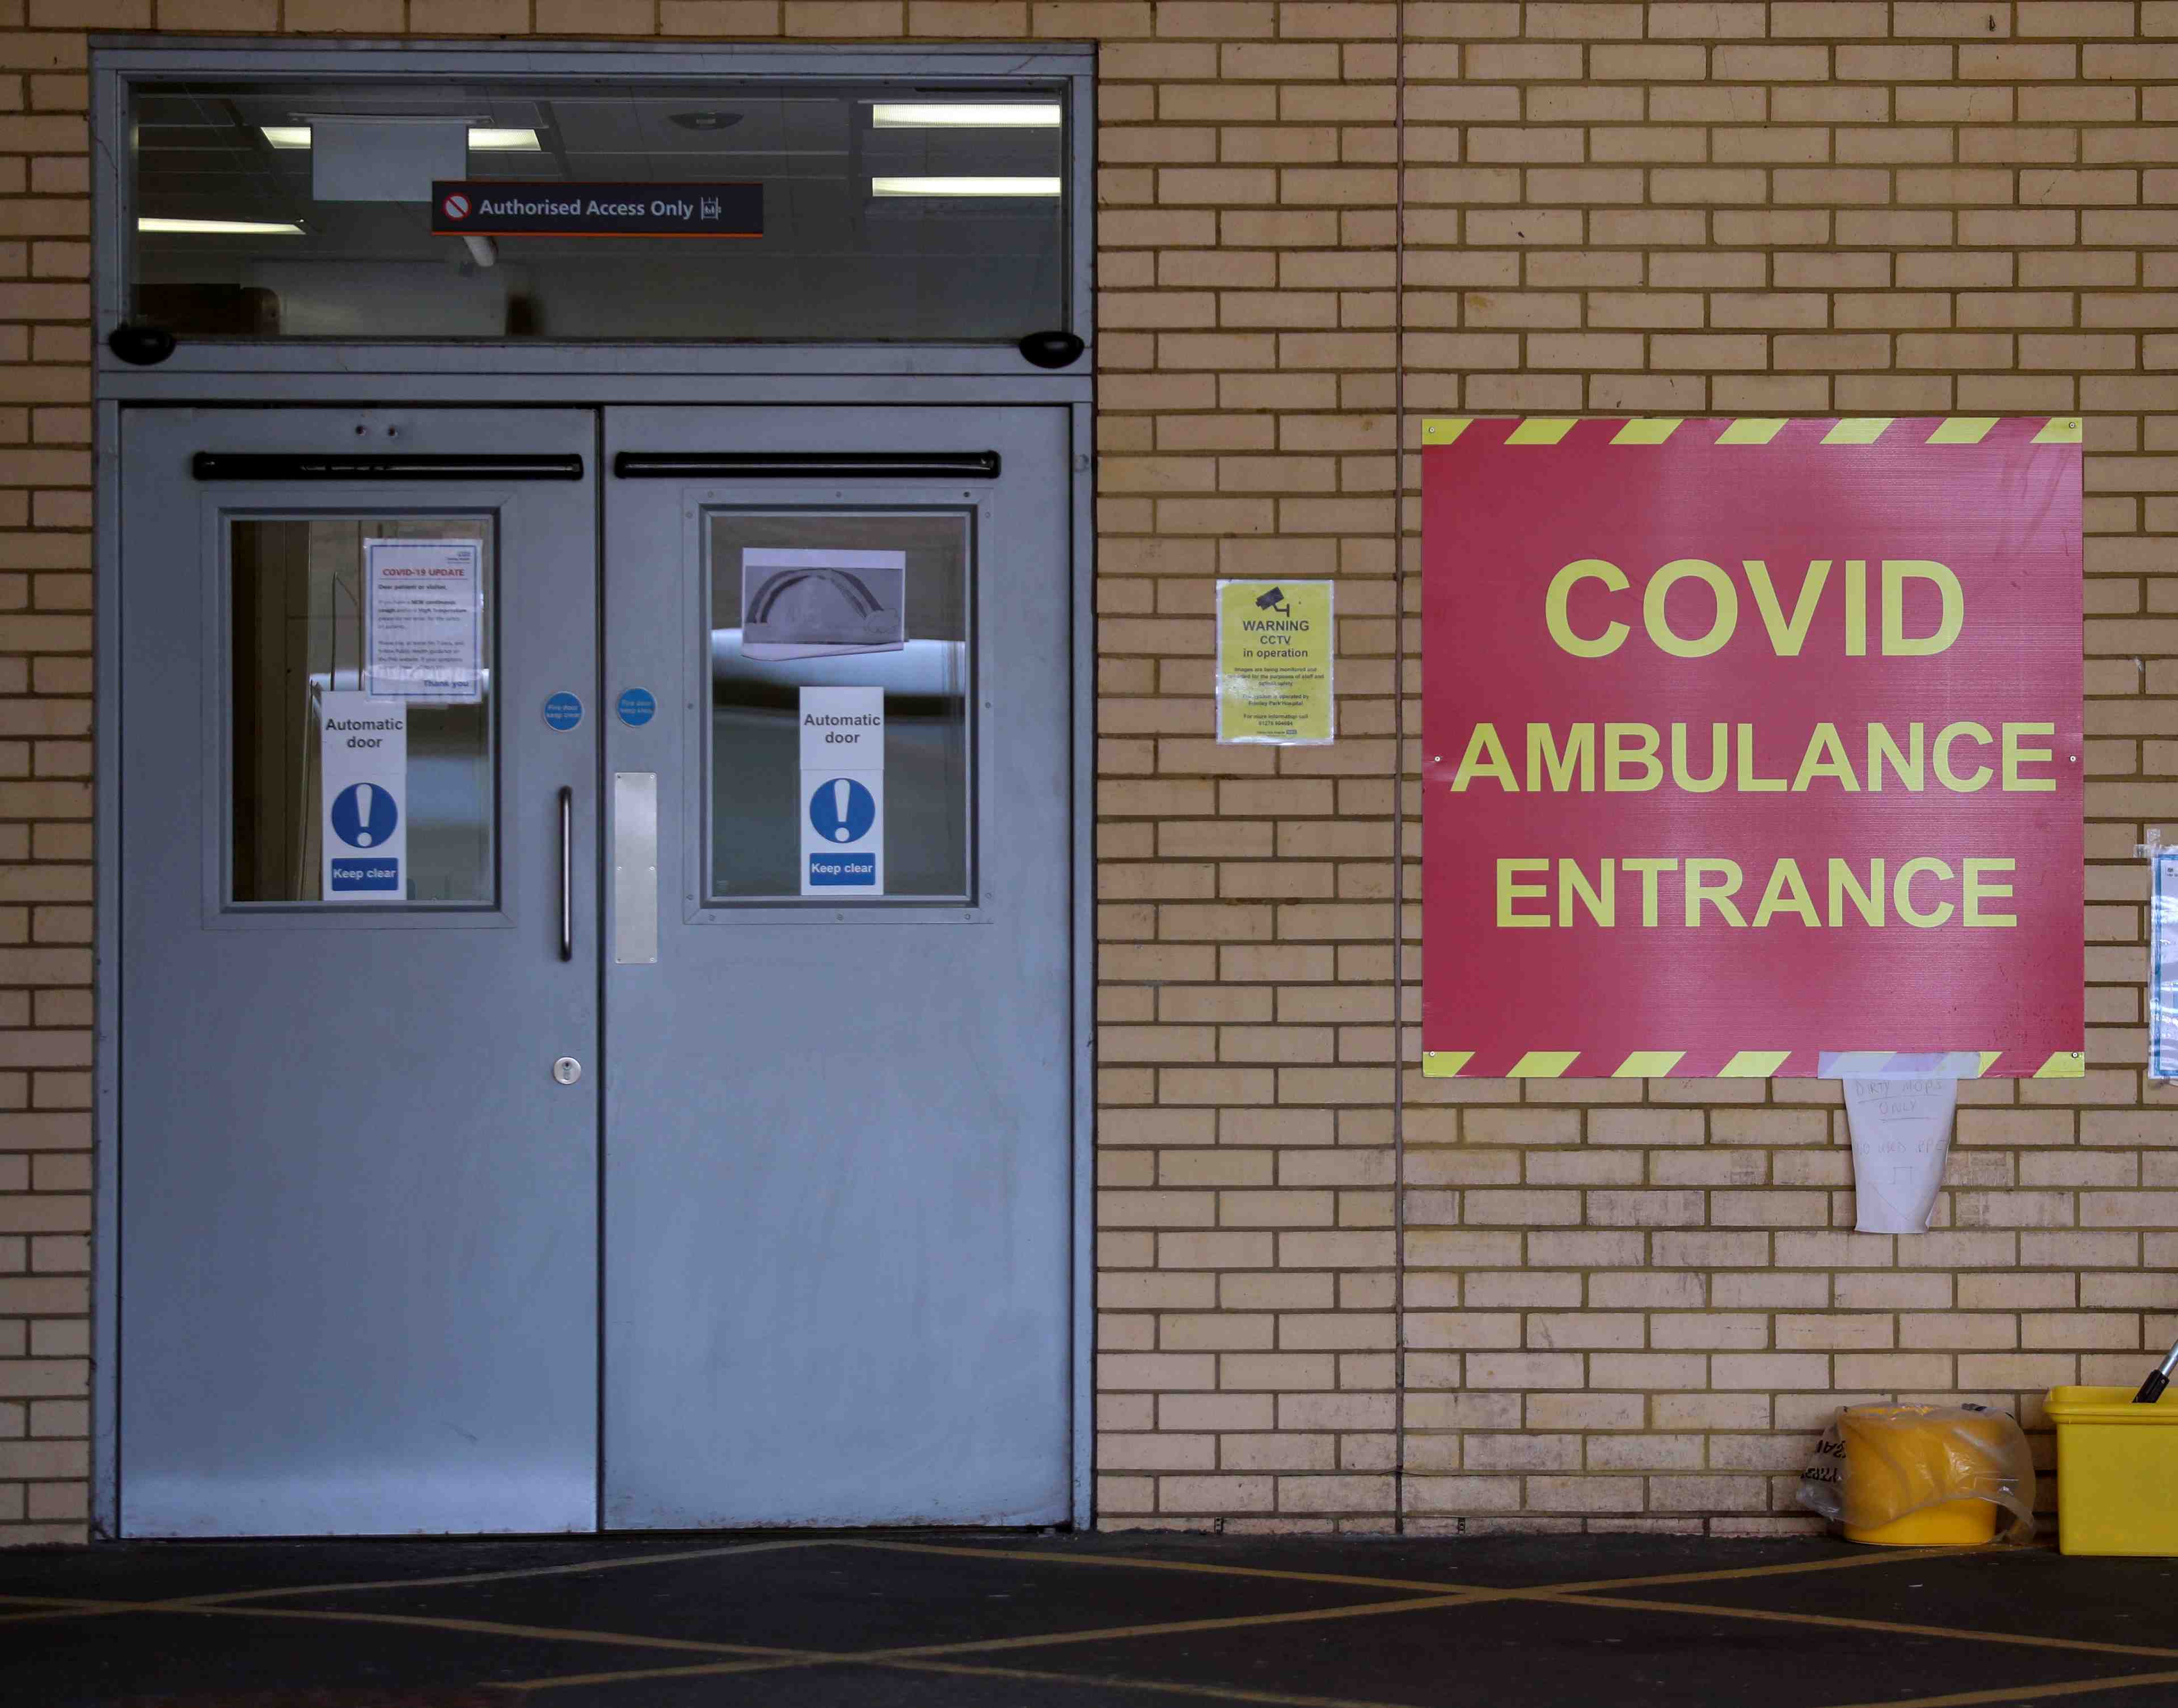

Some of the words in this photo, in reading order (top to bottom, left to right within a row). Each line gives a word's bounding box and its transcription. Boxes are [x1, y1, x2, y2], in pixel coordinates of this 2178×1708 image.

[479, 199, 581, 217] Authorised
[586, 200, 645, 216] Access
[651, 200, 693, 220] Only
[1544, 559, 1965, 657] COVID
[1243, 620, 1309, 631] WARNING
[1260, 635, 1291, 645] CCTV
[1244, 648, 1253, 657] in
[1256, 648, 1308, 659] operation
[326, 718, 403, 731] Automatic
[804, 714, 880, 726] Automatic
[347, 736, 382, 748] door
[825, 731, 860, 743] door
[1450, 722, 2056, 792] AMBULANCE
[333, 868, 364, 880] Keep
[366, 868, 396, 879] clear
[811, 863, 841, 875] Keep
[844, 863, 873, 873] clear
[1496, 858, 2017, 927] ENTRANCE
